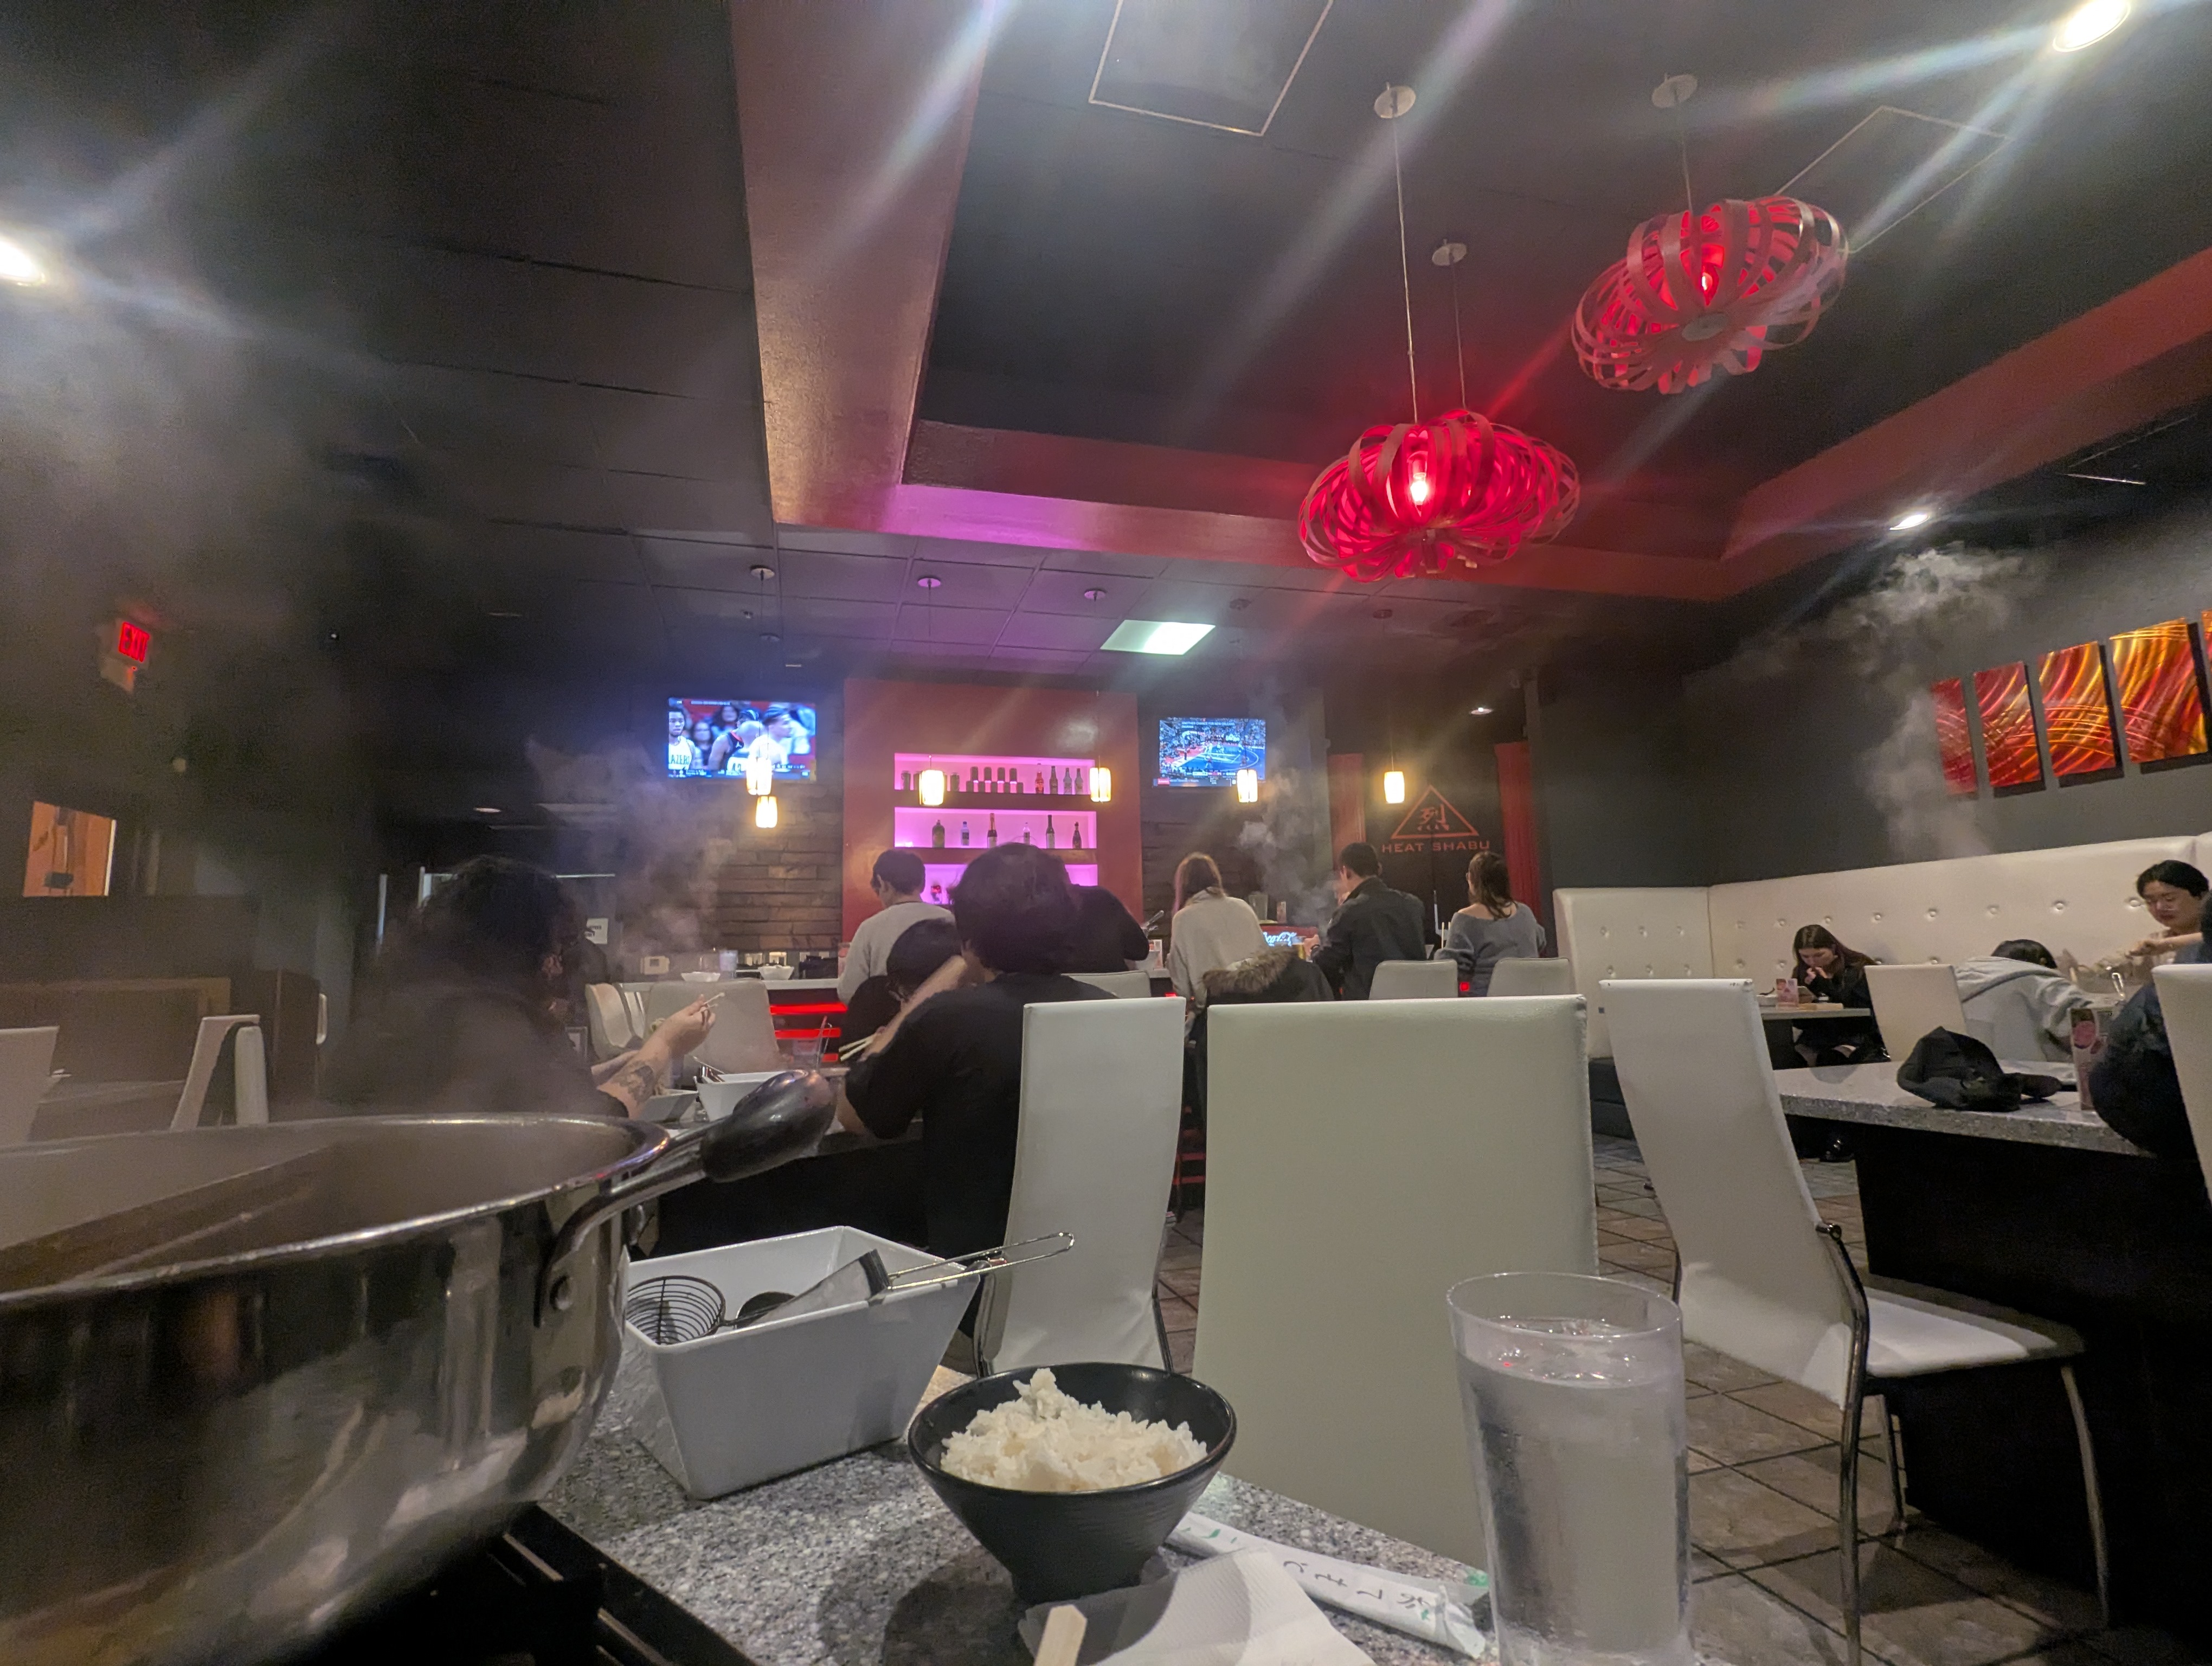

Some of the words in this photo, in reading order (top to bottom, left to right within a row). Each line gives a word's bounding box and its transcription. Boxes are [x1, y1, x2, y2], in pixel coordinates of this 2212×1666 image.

[119, 622, 150, 662] EXIT
[668, 754, 690, 765] AZERS
[1381, 843, 1424, 854] HEAT
[1432, 841, 1490, 852] SHABU
